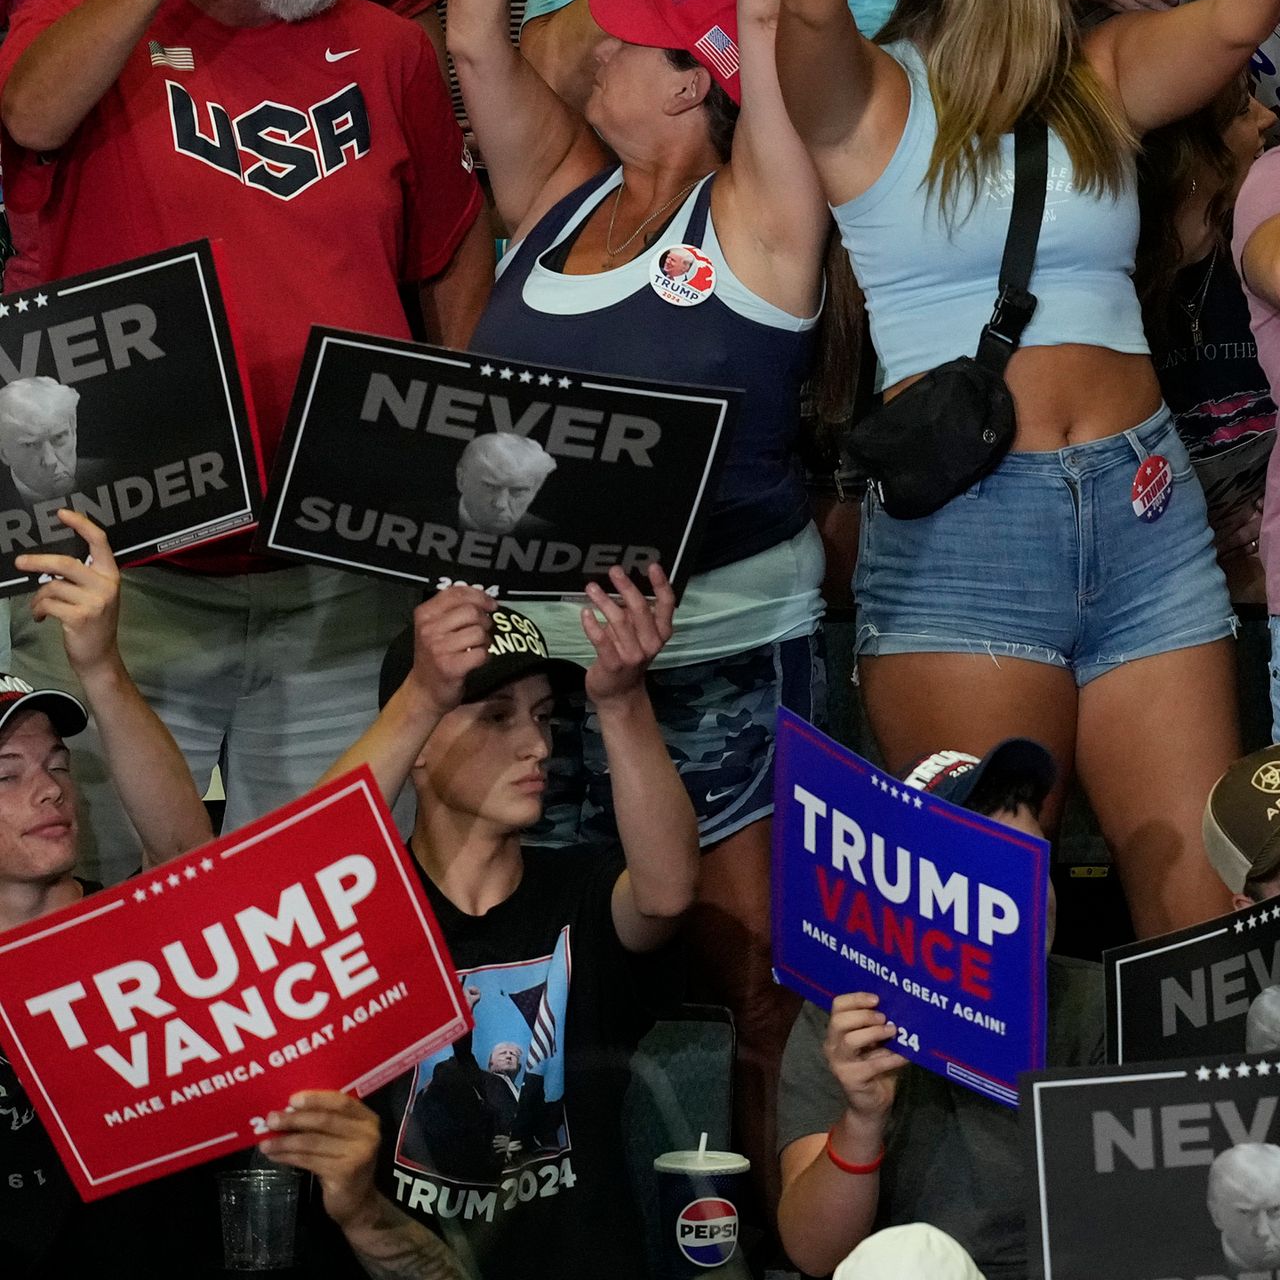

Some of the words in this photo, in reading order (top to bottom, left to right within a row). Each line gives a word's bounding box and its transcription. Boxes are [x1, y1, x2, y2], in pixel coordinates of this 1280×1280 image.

[164, 79, 372, 202] USA
[655, 274, 700, 301] TRUMP
[1220, 341, 1257, 360] THE
[359, 371, 664, 468] NEVER
[294, 494, 662, 579] SURRENDER
[794, 785, 1019, 945] TRUMP
[26, 855, 378, 1054] TRUMP
[803, 920, 836, 951] MAKE
[841, 944, 898, 986] AMERICA
[903, 979, 948, 1009] GREAT
[953, 1003, 1005, 1035] AGAIN!
[818, 869, 989, 998] VANCE
[93, 923, 382, 1099] VANCE
[104, 1096, 164, 1126] MAKE
[171, 1061, 264, 1104] AMERICA
[269, 1024, 334, 1067] GREAT
[343, 982, 407, 1031] AGAIN!
[500, 1157, 577, 1212] 2024
[680, 1221, 738, 1240] PEPSI
